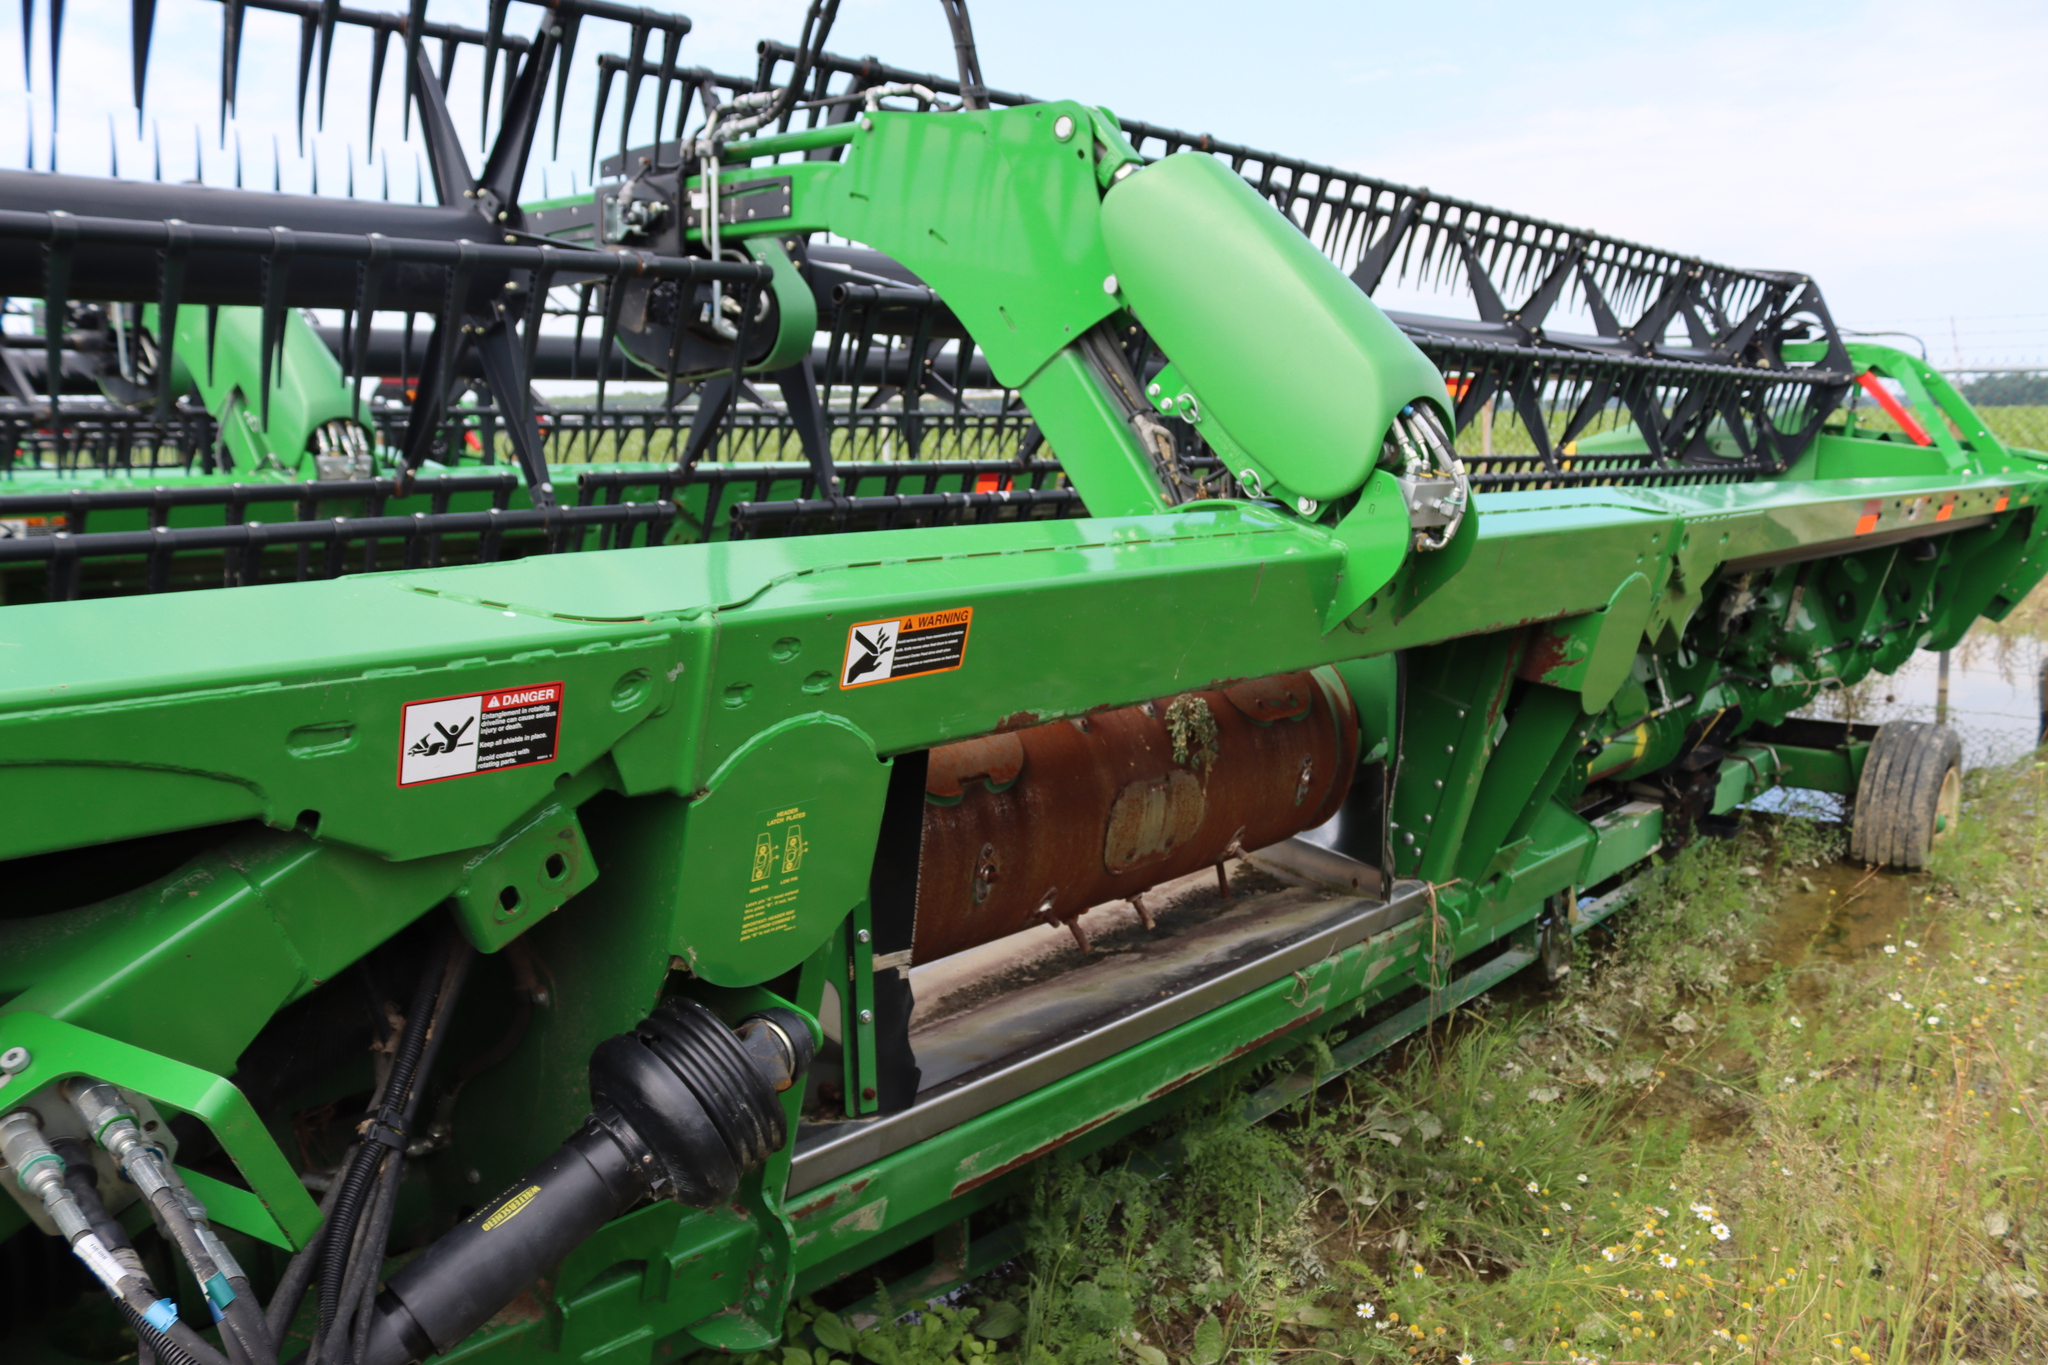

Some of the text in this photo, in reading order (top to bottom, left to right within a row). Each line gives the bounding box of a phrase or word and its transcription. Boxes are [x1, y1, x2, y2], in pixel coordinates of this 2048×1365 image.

[919, 610, 968, 627] WARNING
[502, 689, 554, 705] DANGER
[482, 708, 520, 720] Entanglement
[481, 719, 505, 727] driveline
[531, 733, 547, 741] place.
[496, 751, 516, 759] contact
[500, 758, 516, 766] parts.
[776, 808, 798, 817] HEADER
[767, 812, 806, 826] LATCH PLATES
[482, 1185, 541, 1231] WALTERSCHEID
